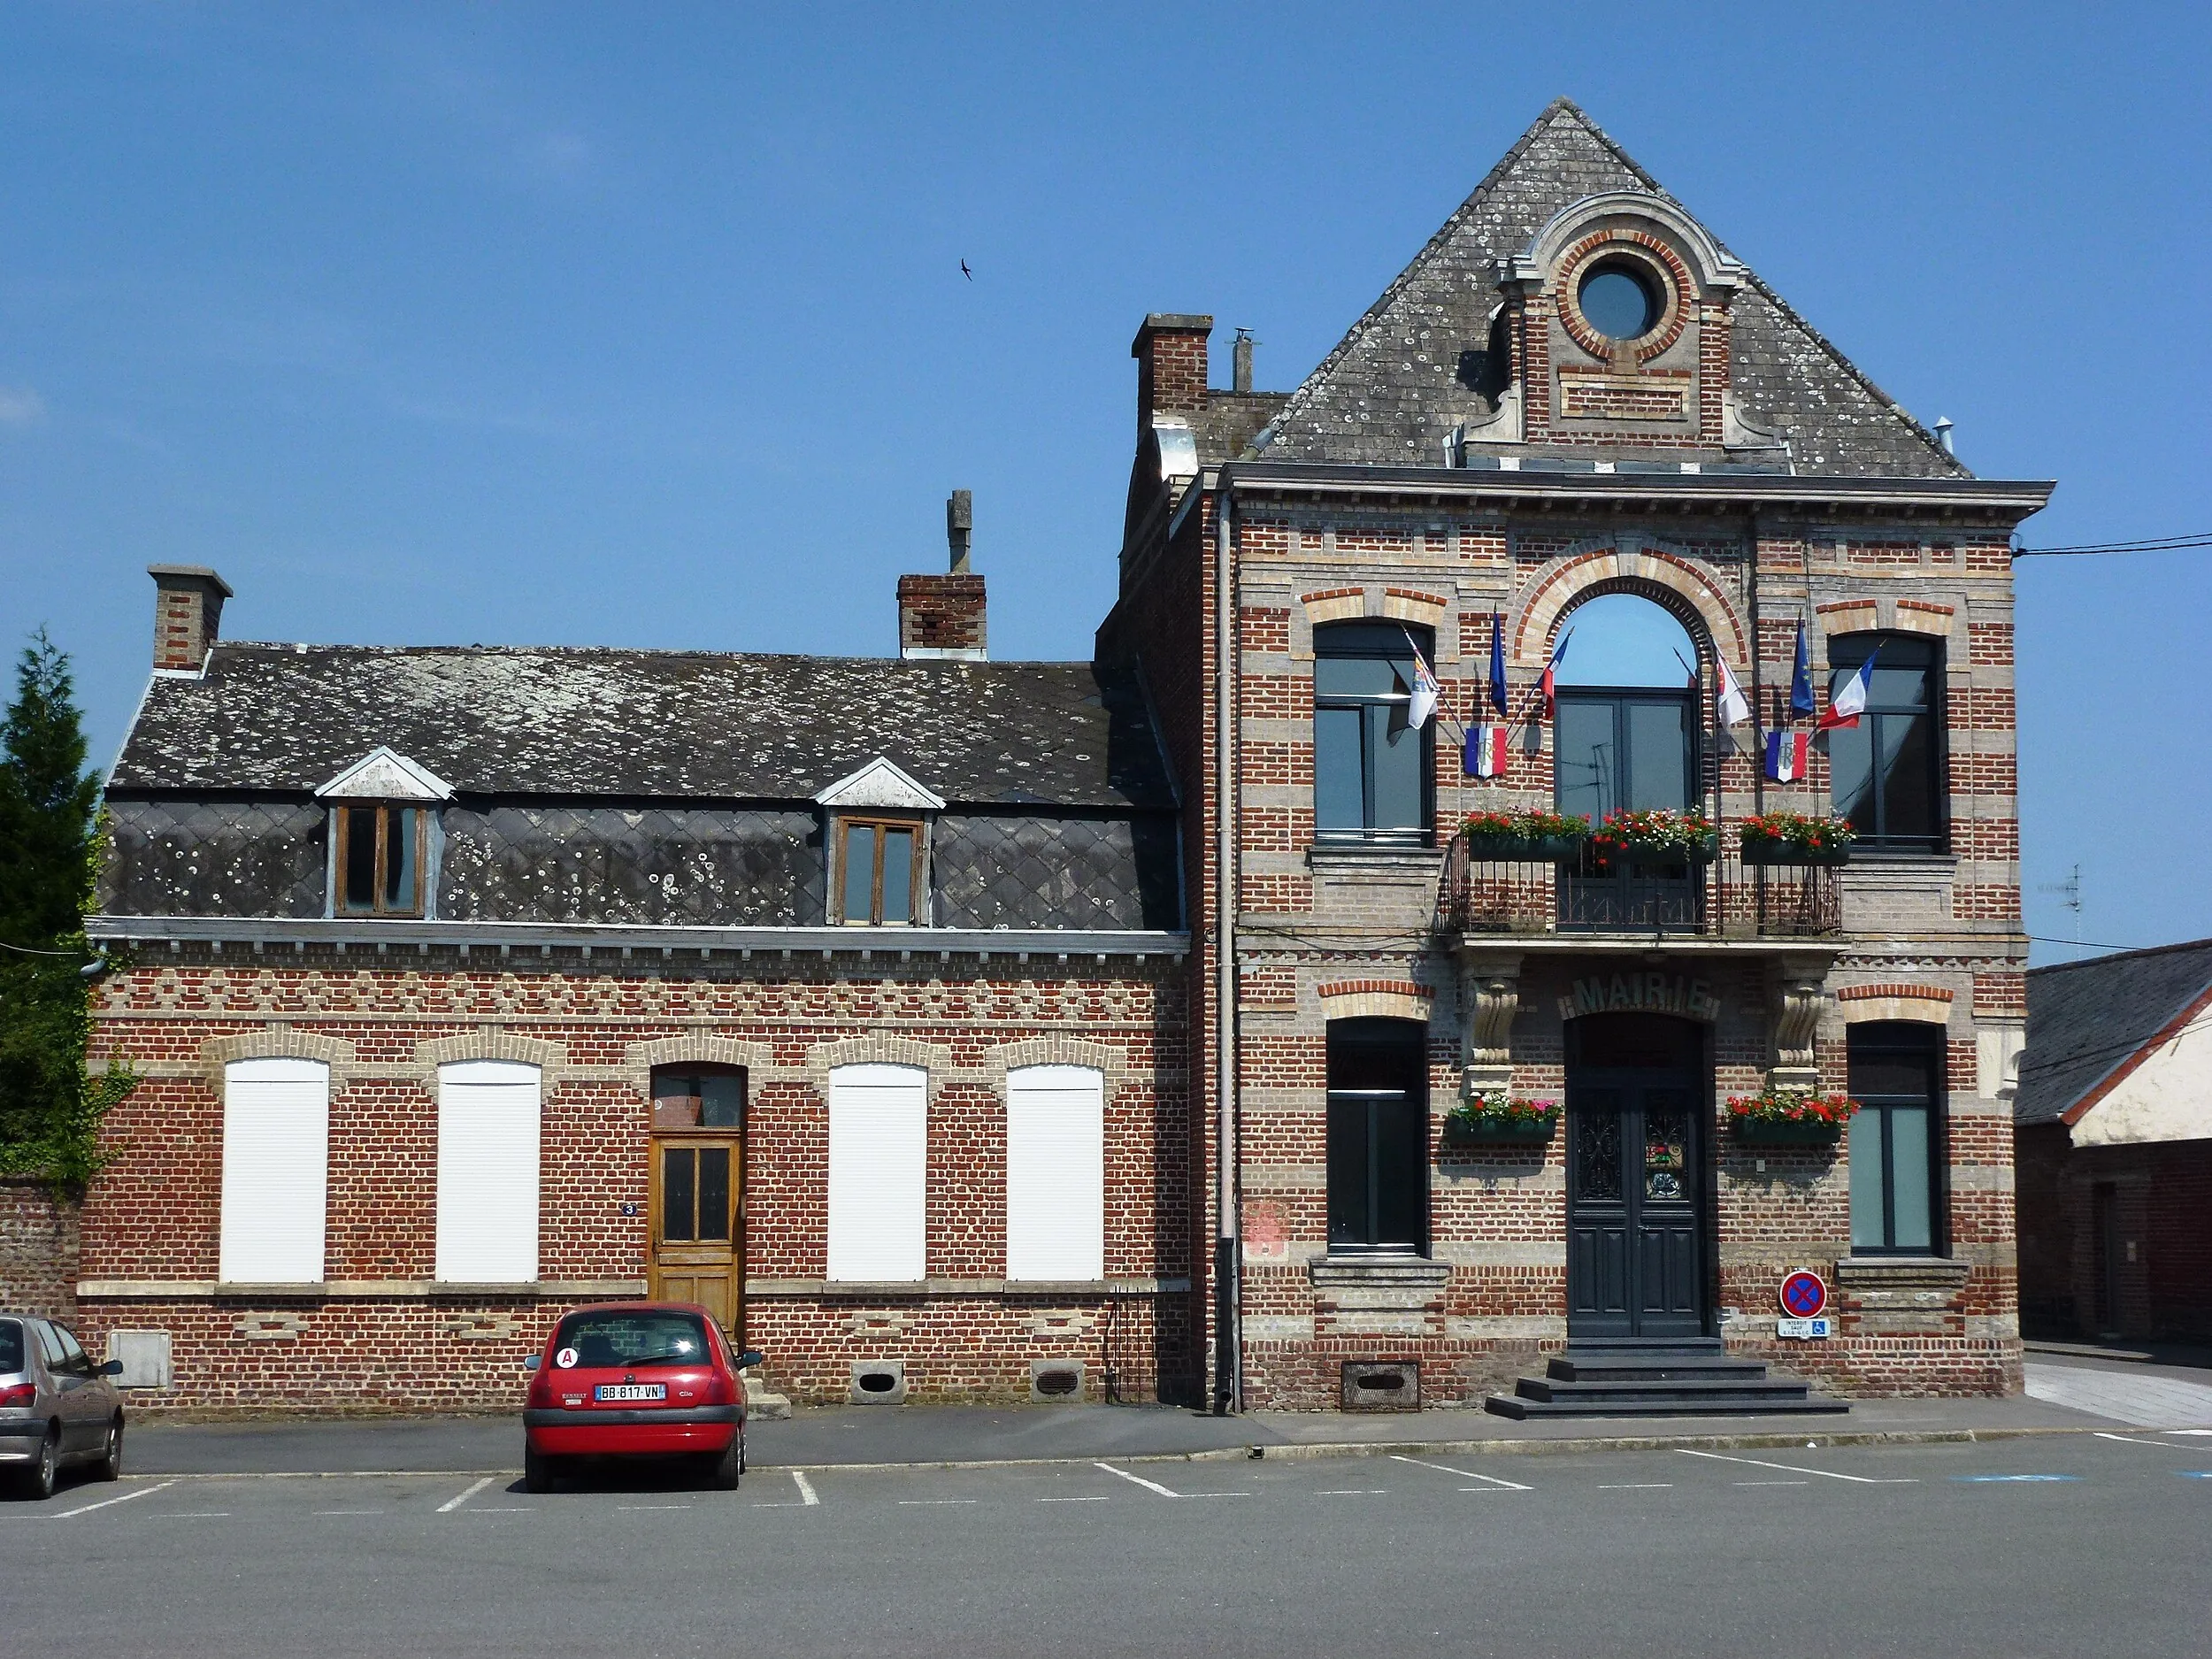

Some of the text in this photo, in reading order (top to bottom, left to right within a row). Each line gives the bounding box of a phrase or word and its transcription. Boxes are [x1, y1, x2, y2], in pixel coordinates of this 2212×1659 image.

[1572, 972, 1711, 1012] MAIRIE
[626, 1205, 634, 1214] 3
[562, 1350, 572, 1363] A
